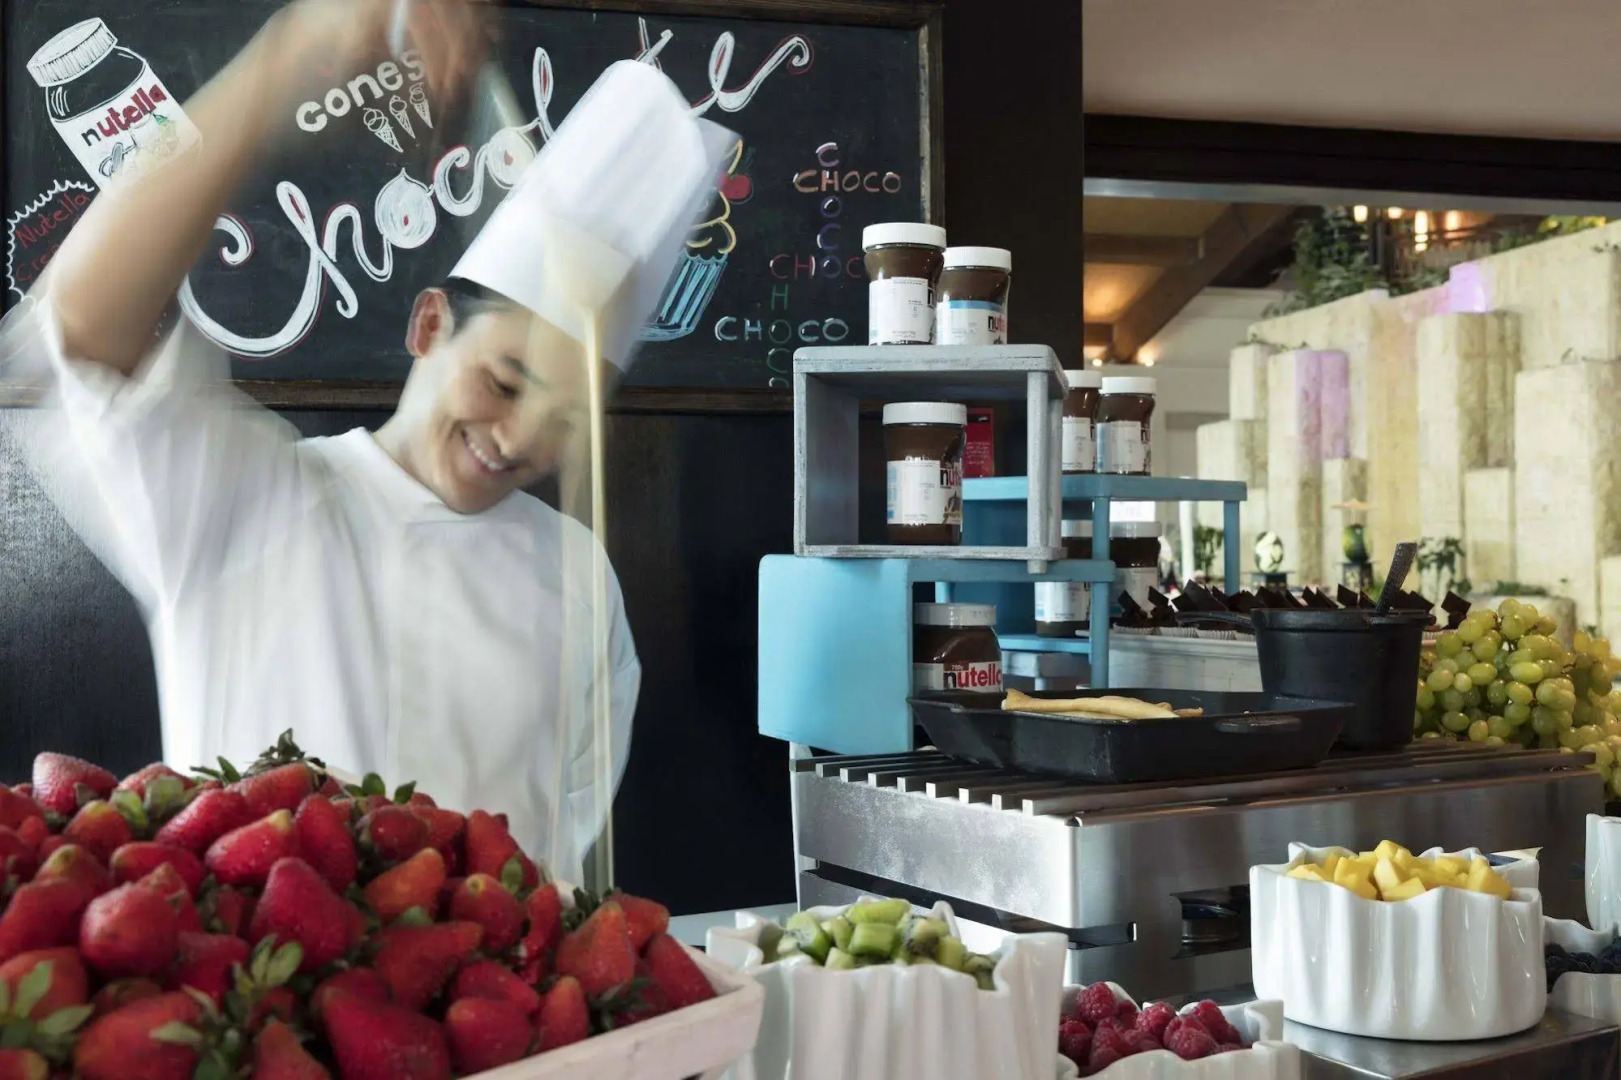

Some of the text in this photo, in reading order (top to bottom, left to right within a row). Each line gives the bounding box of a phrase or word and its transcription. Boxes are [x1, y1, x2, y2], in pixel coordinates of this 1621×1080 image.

[81, 84, 167, 147] nutella
[296, 50, 426, 132] cones
[178, 17, 815, 357] Chocole
[792, 169, 901, 193] CHOCO
[15, 192, 90, 249] Nutella
[769, 253, 863, 279] CHOC
[714, 316, 849, 344] CHOCO
